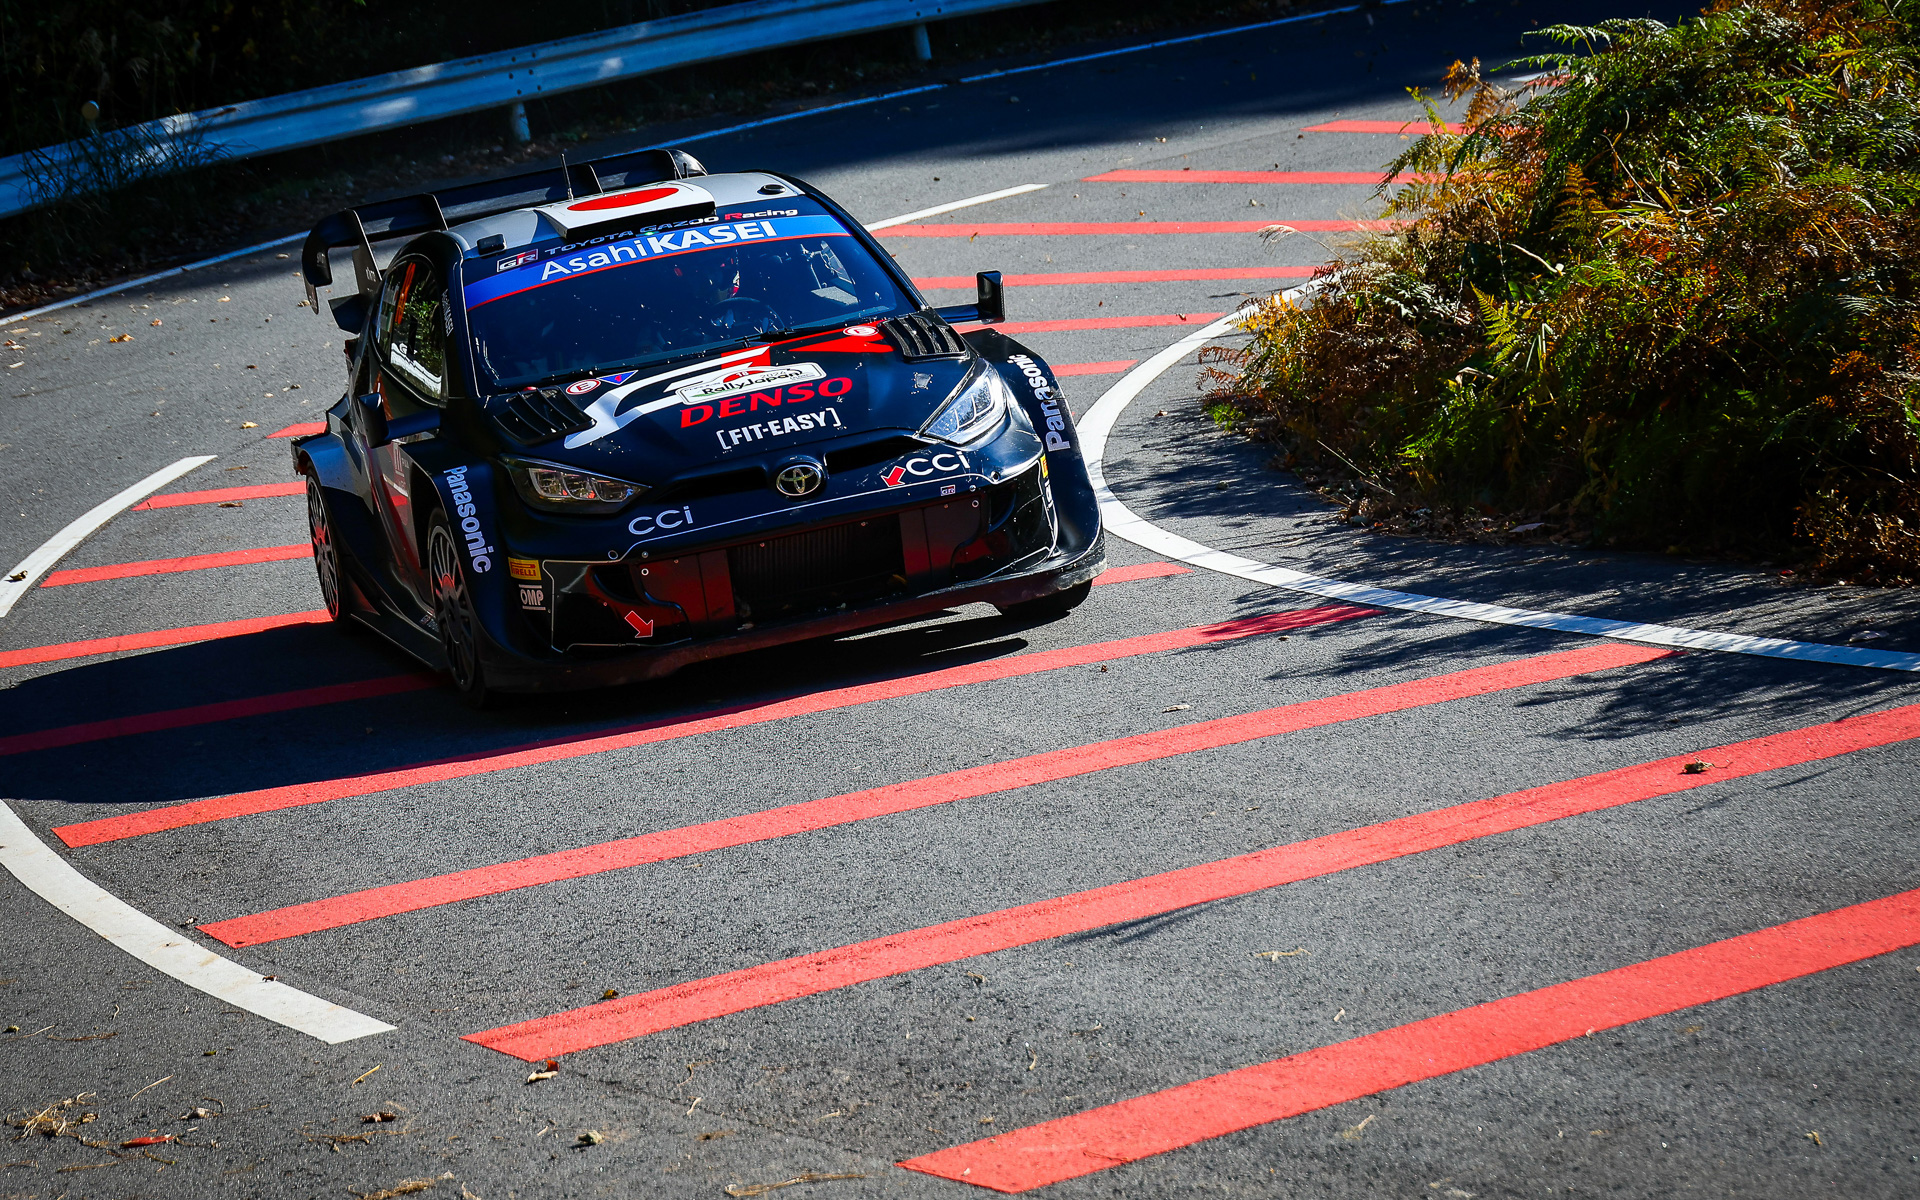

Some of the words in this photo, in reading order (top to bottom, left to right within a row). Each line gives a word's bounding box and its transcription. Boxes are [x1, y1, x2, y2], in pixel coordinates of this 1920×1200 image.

[541, 220, 777, 281] AsahiKASEI
[545, 230, 634, 255] TOYOTA
[639, 216, 719, 233] GAZOO
[724, 208, 798, 221] Racing
[499, 252, 537, 271] GR
[680, 377, 853, 429] DENSO
[1007, 354, 1071, 452] Panasonic
[443, 465, 494, 574] Panasonic
[520, 588, 544, 606] OMP
